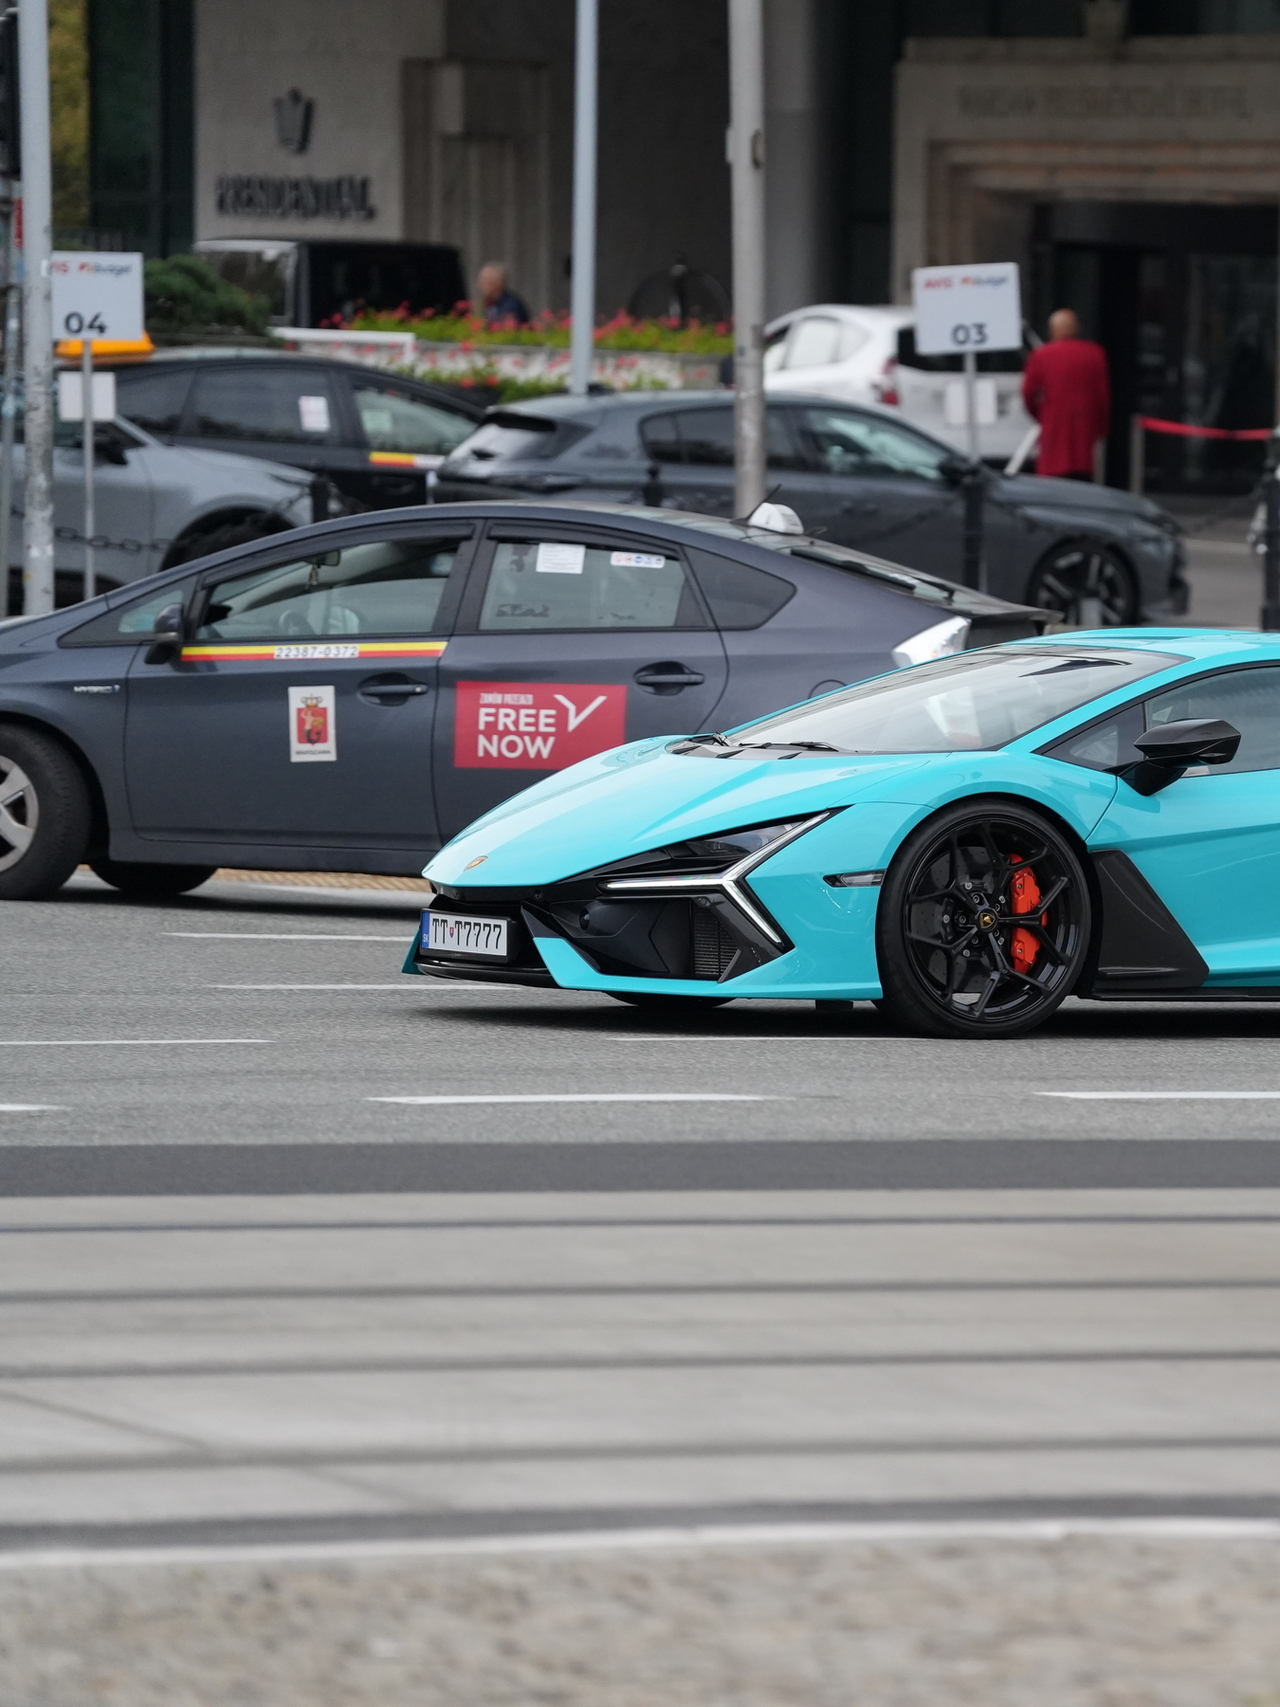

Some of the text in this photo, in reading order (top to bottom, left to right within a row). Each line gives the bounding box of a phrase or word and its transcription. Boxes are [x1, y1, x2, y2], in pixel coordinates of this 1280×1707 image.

[64, 311, 107, 336] 04
[951, 323, 988, 346] 03
[276, 645, 358, 658] 22387-0372
[478, 707, 557, 732] FREE
[477, 734, 556, 759] NOW
